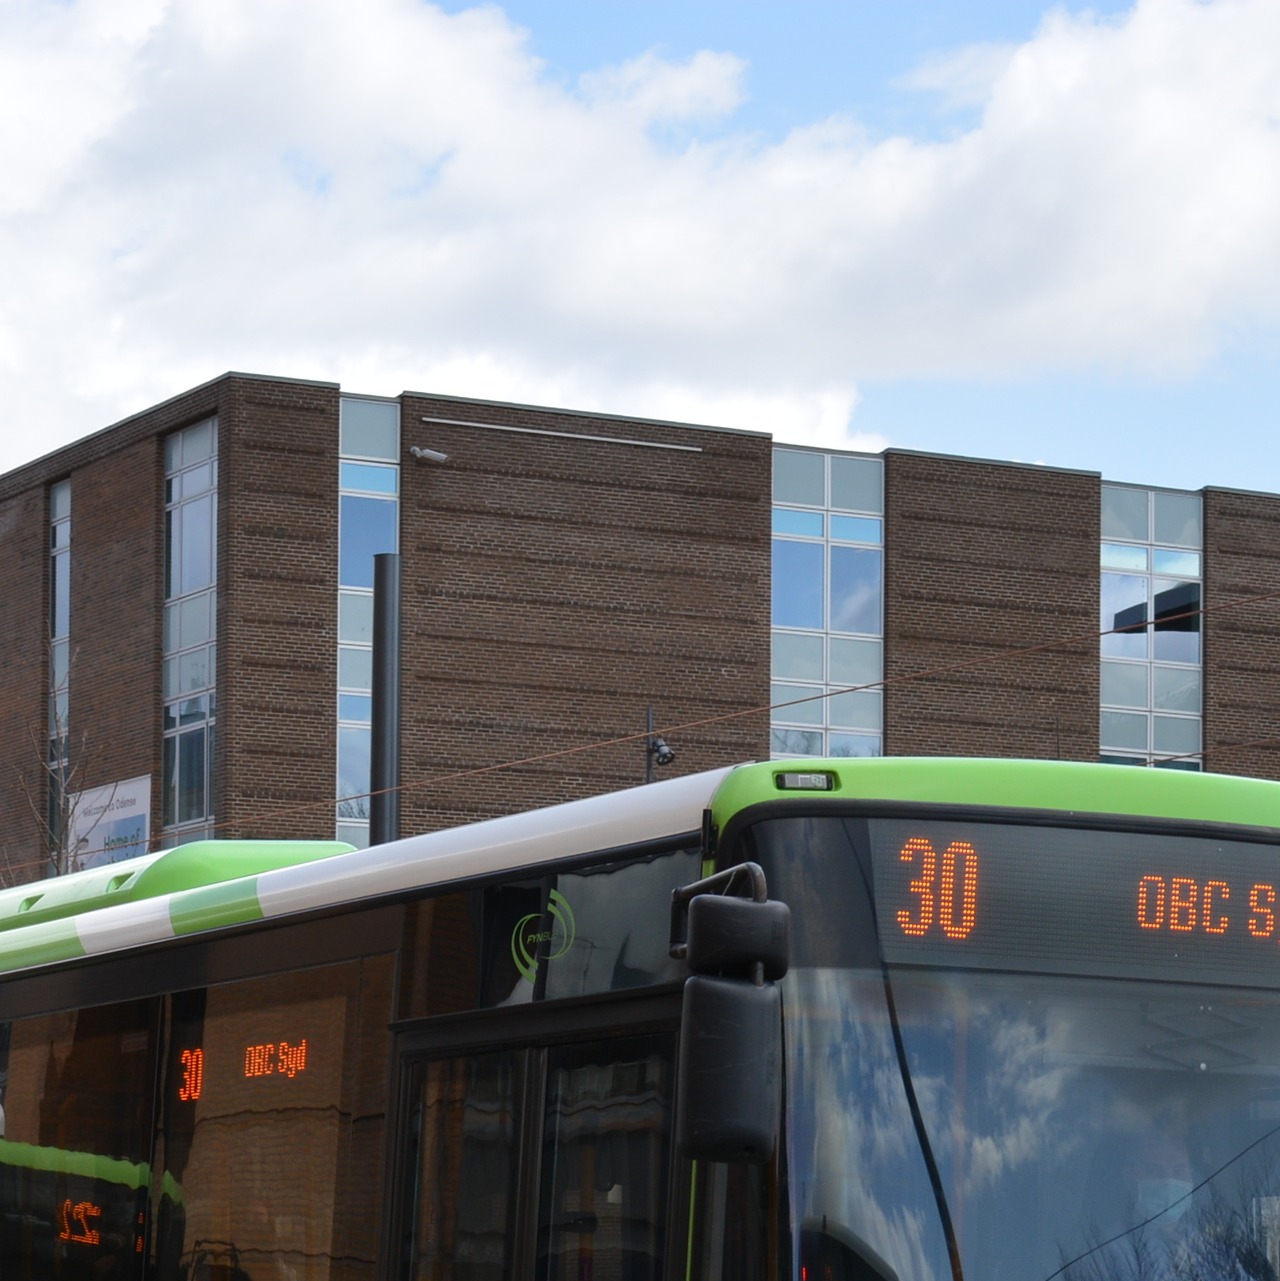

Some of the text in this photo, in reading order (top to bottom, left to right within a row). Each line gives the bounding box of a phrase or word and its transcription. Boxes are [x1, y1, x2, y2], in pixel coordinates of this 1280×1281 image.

[897, 837, 979, 939] 30
[1137, 874, 1230, 935] OBC
[179, 1048, 203, 1101] 30
[245, 1039, 307, 1078] OBC Syd
